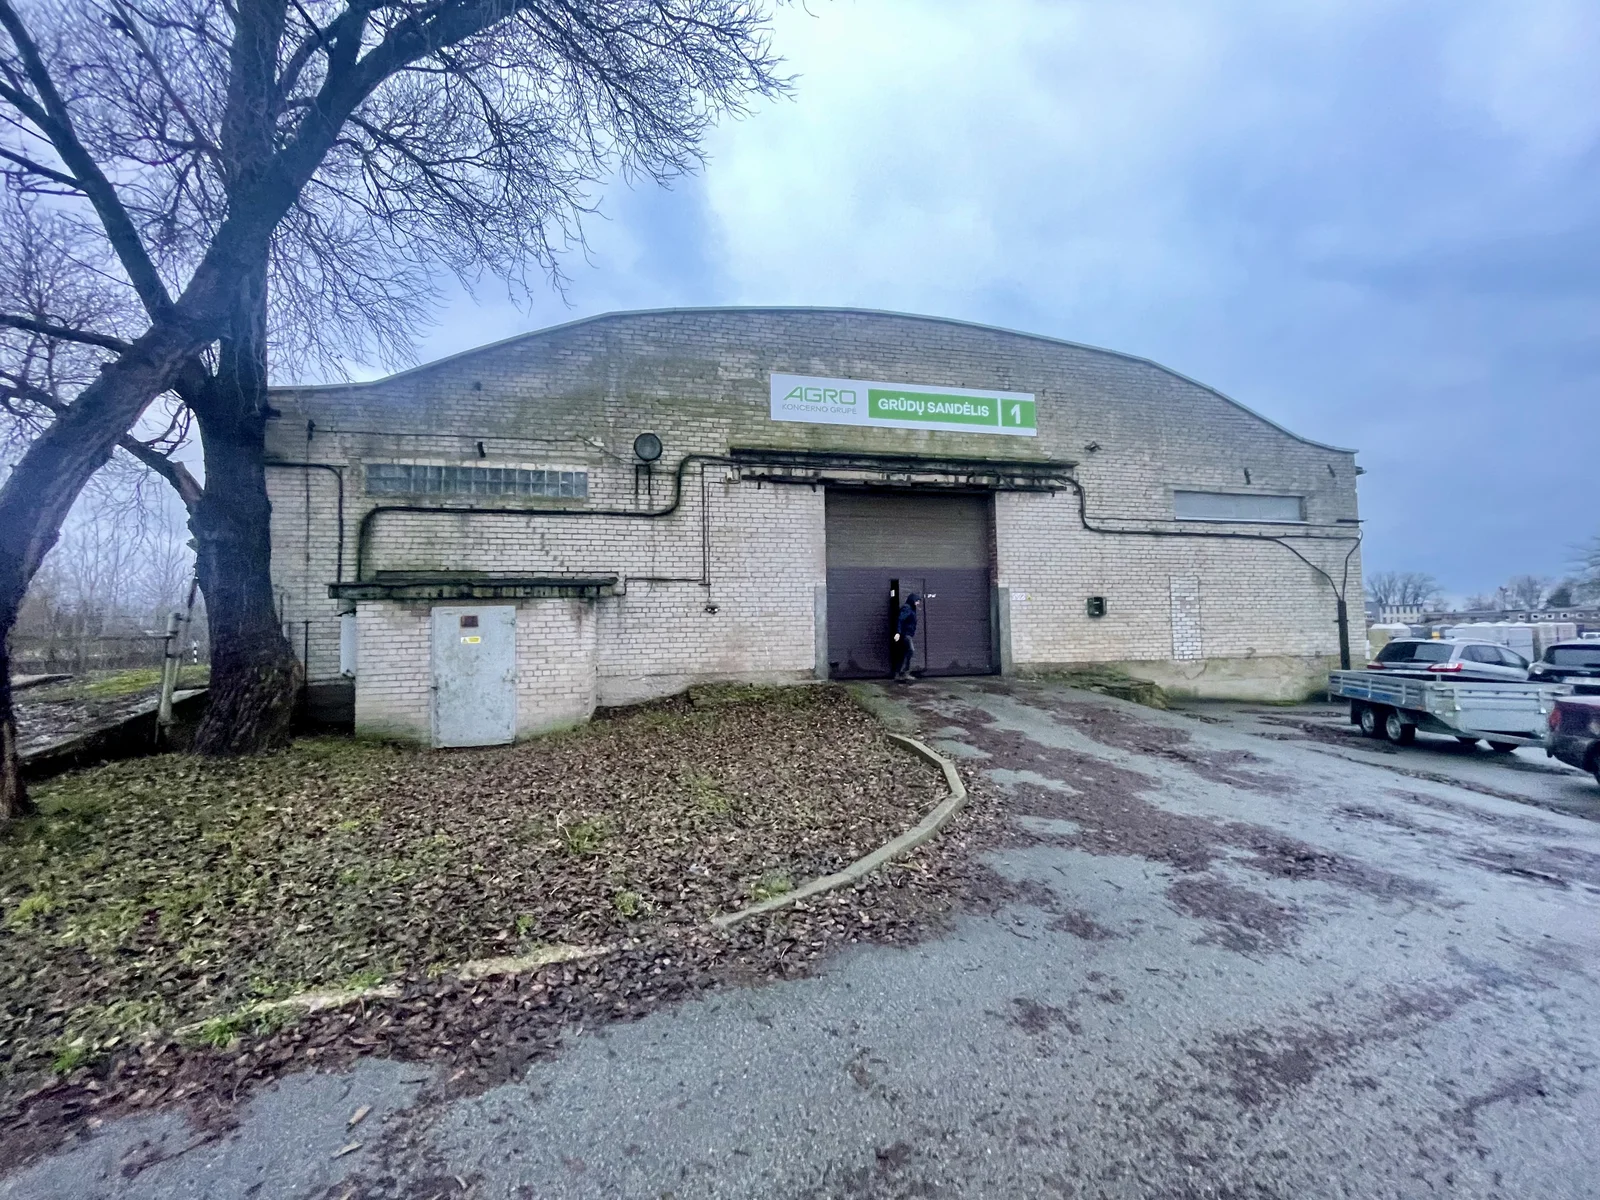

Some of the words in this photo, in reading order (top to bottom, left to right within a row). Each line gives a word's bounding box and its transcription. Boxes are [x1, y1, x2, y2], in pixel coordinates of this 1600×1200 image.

[783, 386, 857, 405] AGRO
[781, 403, 829, 413] KONCERNO
[878, 398, 925, 415] GRŪDŲ
[927, 402, 990, 417] SANDĖLIS
[1010, 404, 1021, 424] 1
